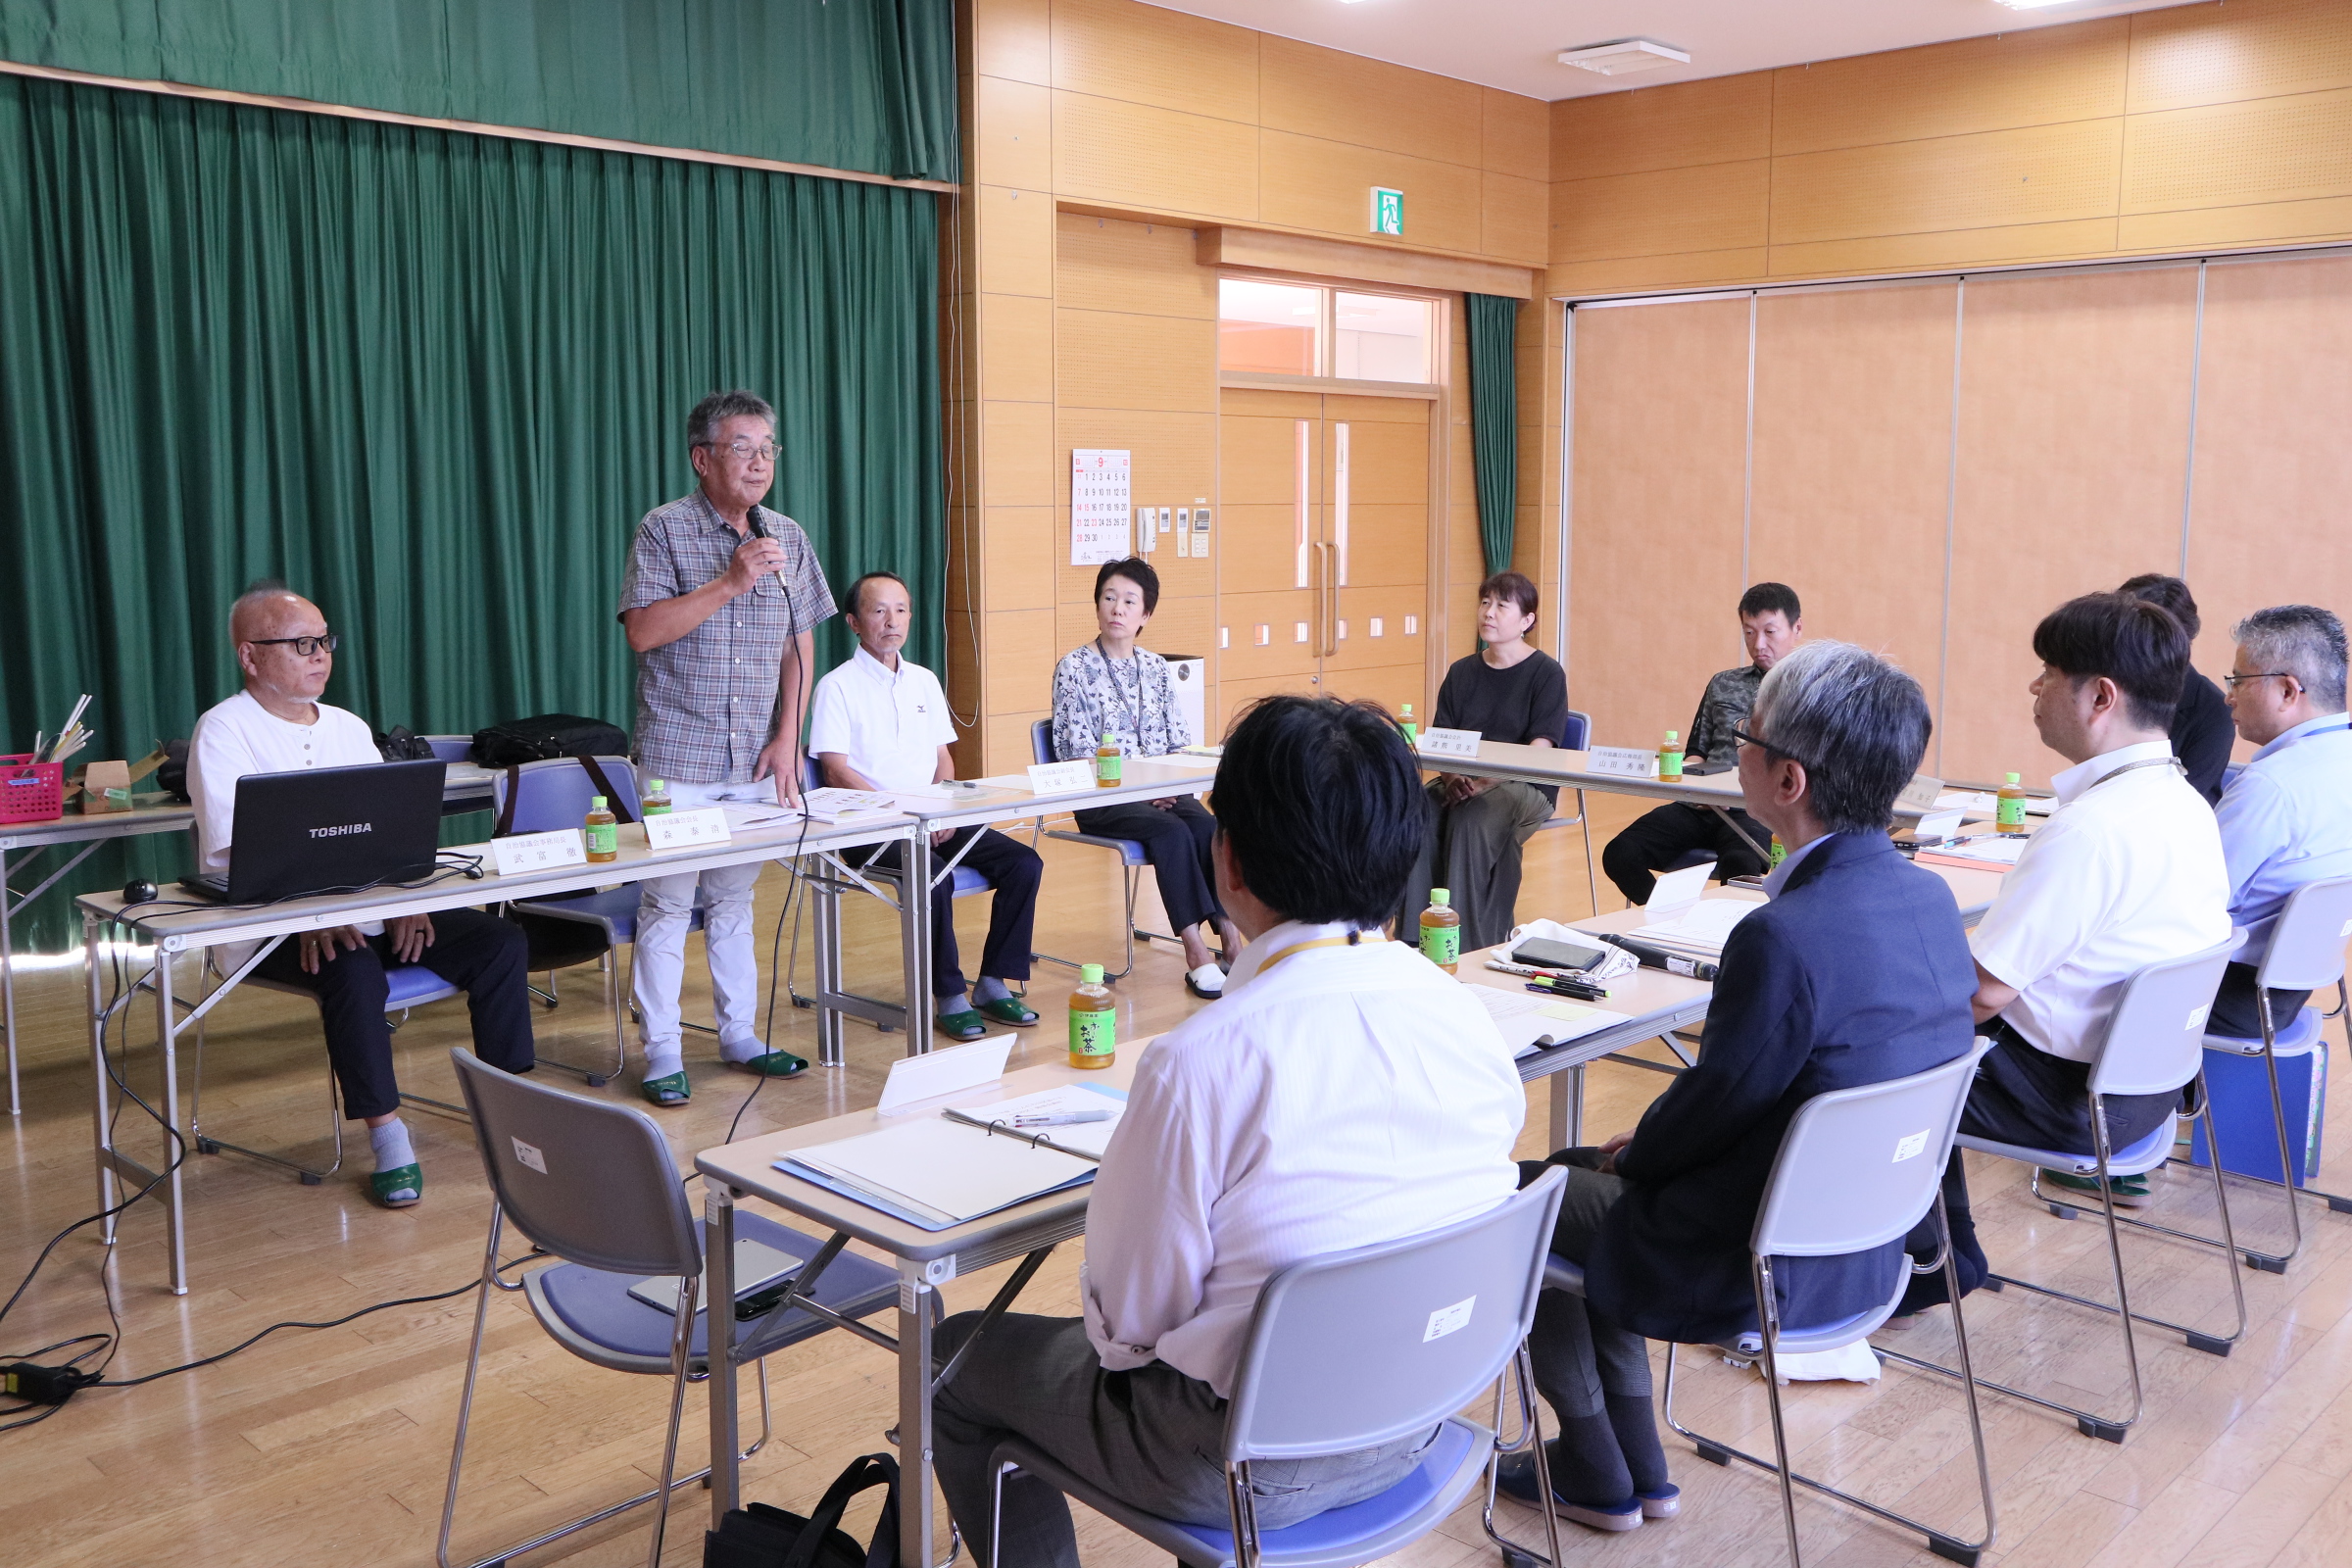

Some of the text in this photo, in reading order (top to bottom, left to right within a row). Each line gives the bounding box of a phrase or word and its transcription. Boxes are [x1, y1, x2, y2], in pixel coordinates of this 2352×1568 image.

[1098, 457, 1103, 467] 9
[1076, 503, 1127, 512] 14 15 16 17 18 19 20
[309, 822, 372, 839] TOSHIBA
